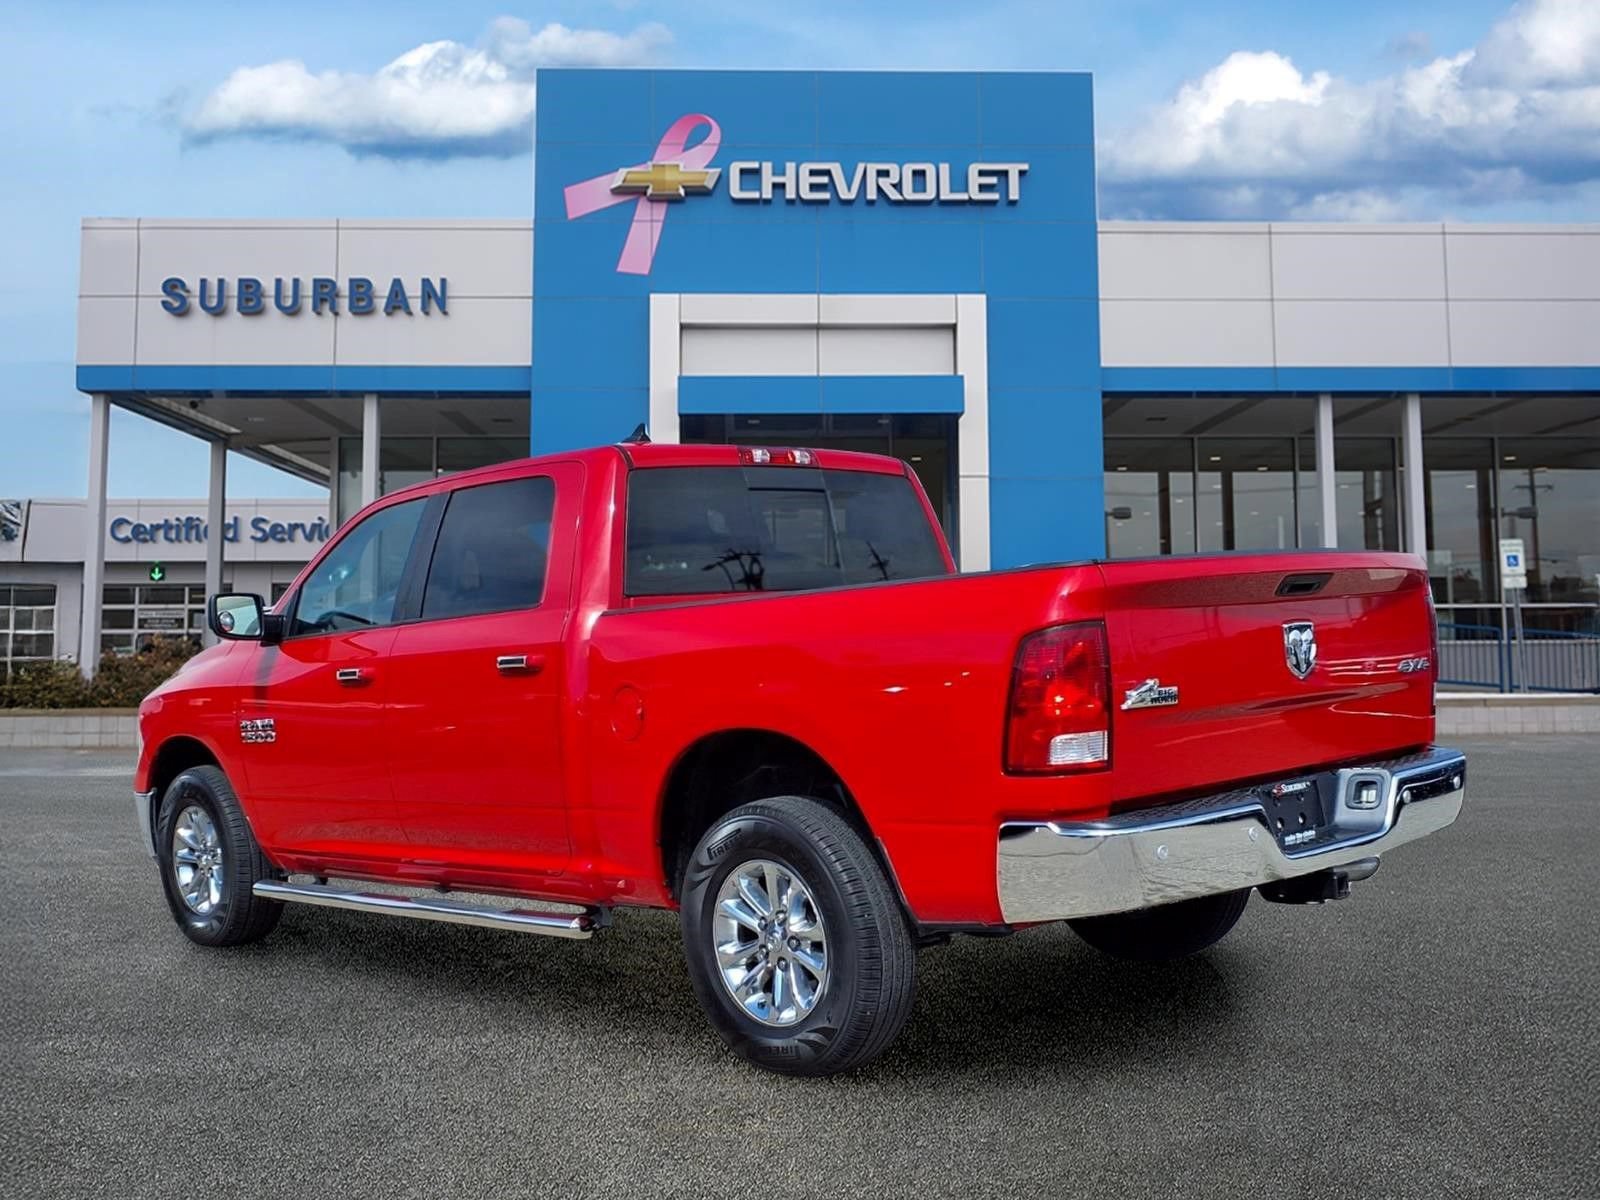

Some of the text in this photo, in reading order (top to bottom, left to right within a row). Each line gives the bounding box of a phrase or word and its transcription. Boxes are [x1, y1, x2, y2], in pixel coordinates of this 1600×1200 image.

[729, 161, 1029, 201] CHEVROLET
[160, 276, 449, 317] SUBURBAN
[110, 515, 330, 544] Certifid Servi
